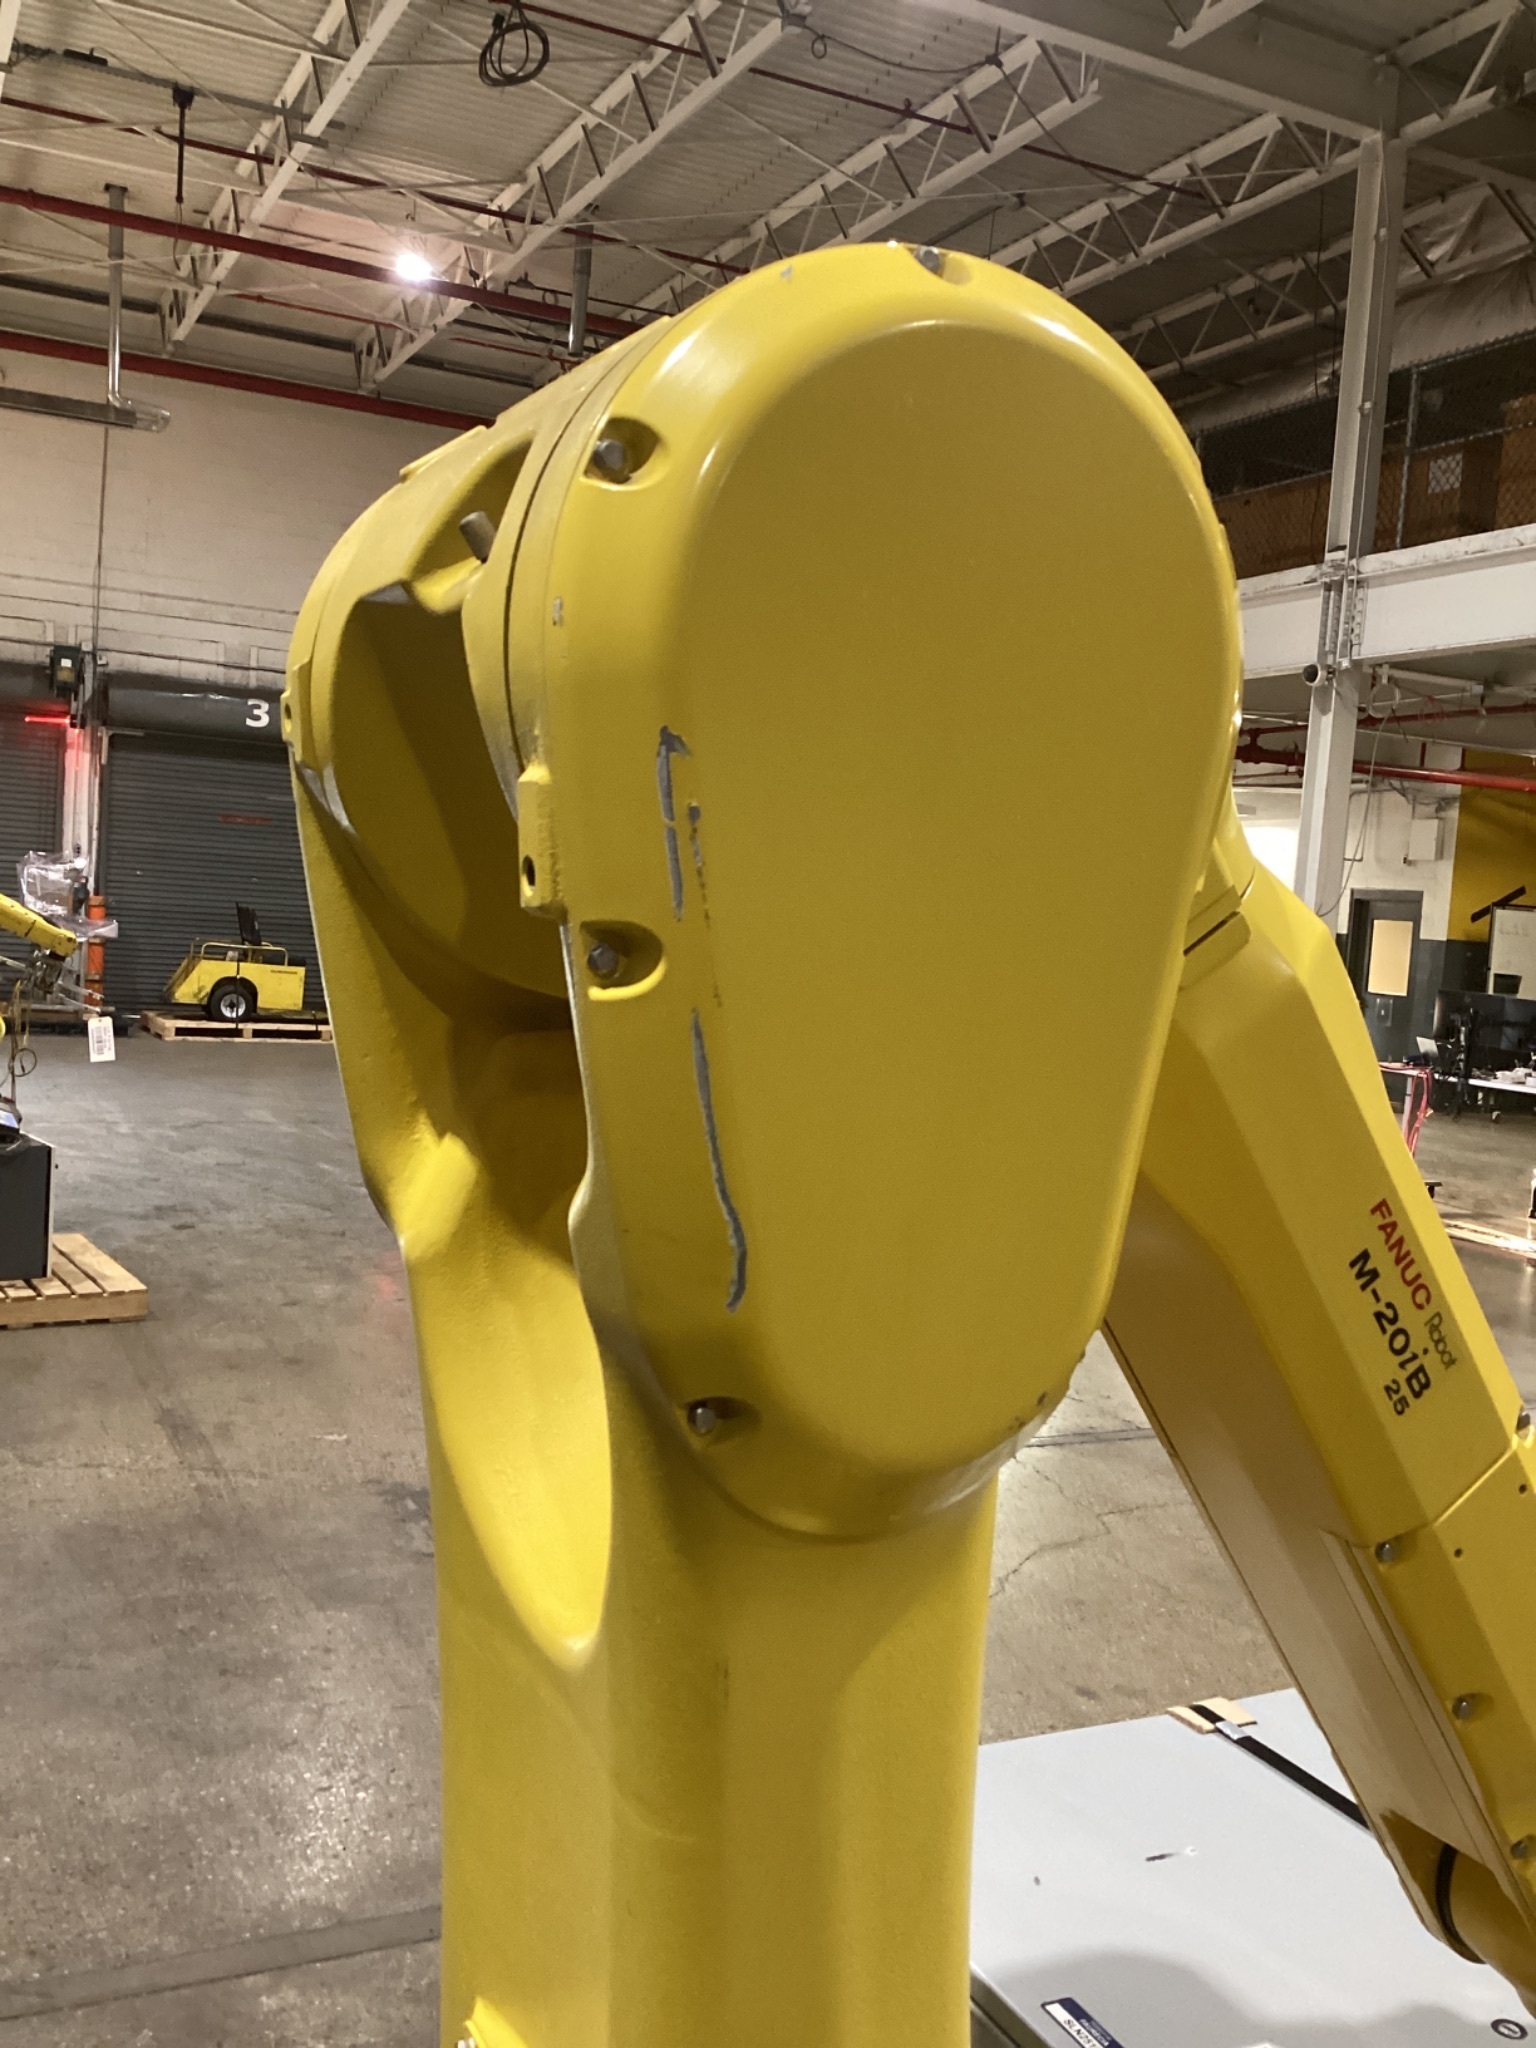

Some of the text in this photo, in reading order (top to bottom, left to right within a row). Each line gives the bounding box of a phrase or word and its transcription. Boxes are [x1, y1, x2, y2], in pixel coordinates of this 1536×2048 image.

[246, 698, 270, 728] 3
[1349, 1248, 1432, 1400] M-20iB
[1370, 1198, 1458, 1371] FANUC Robot
[1383, 1378, 1410, 1416] 25
